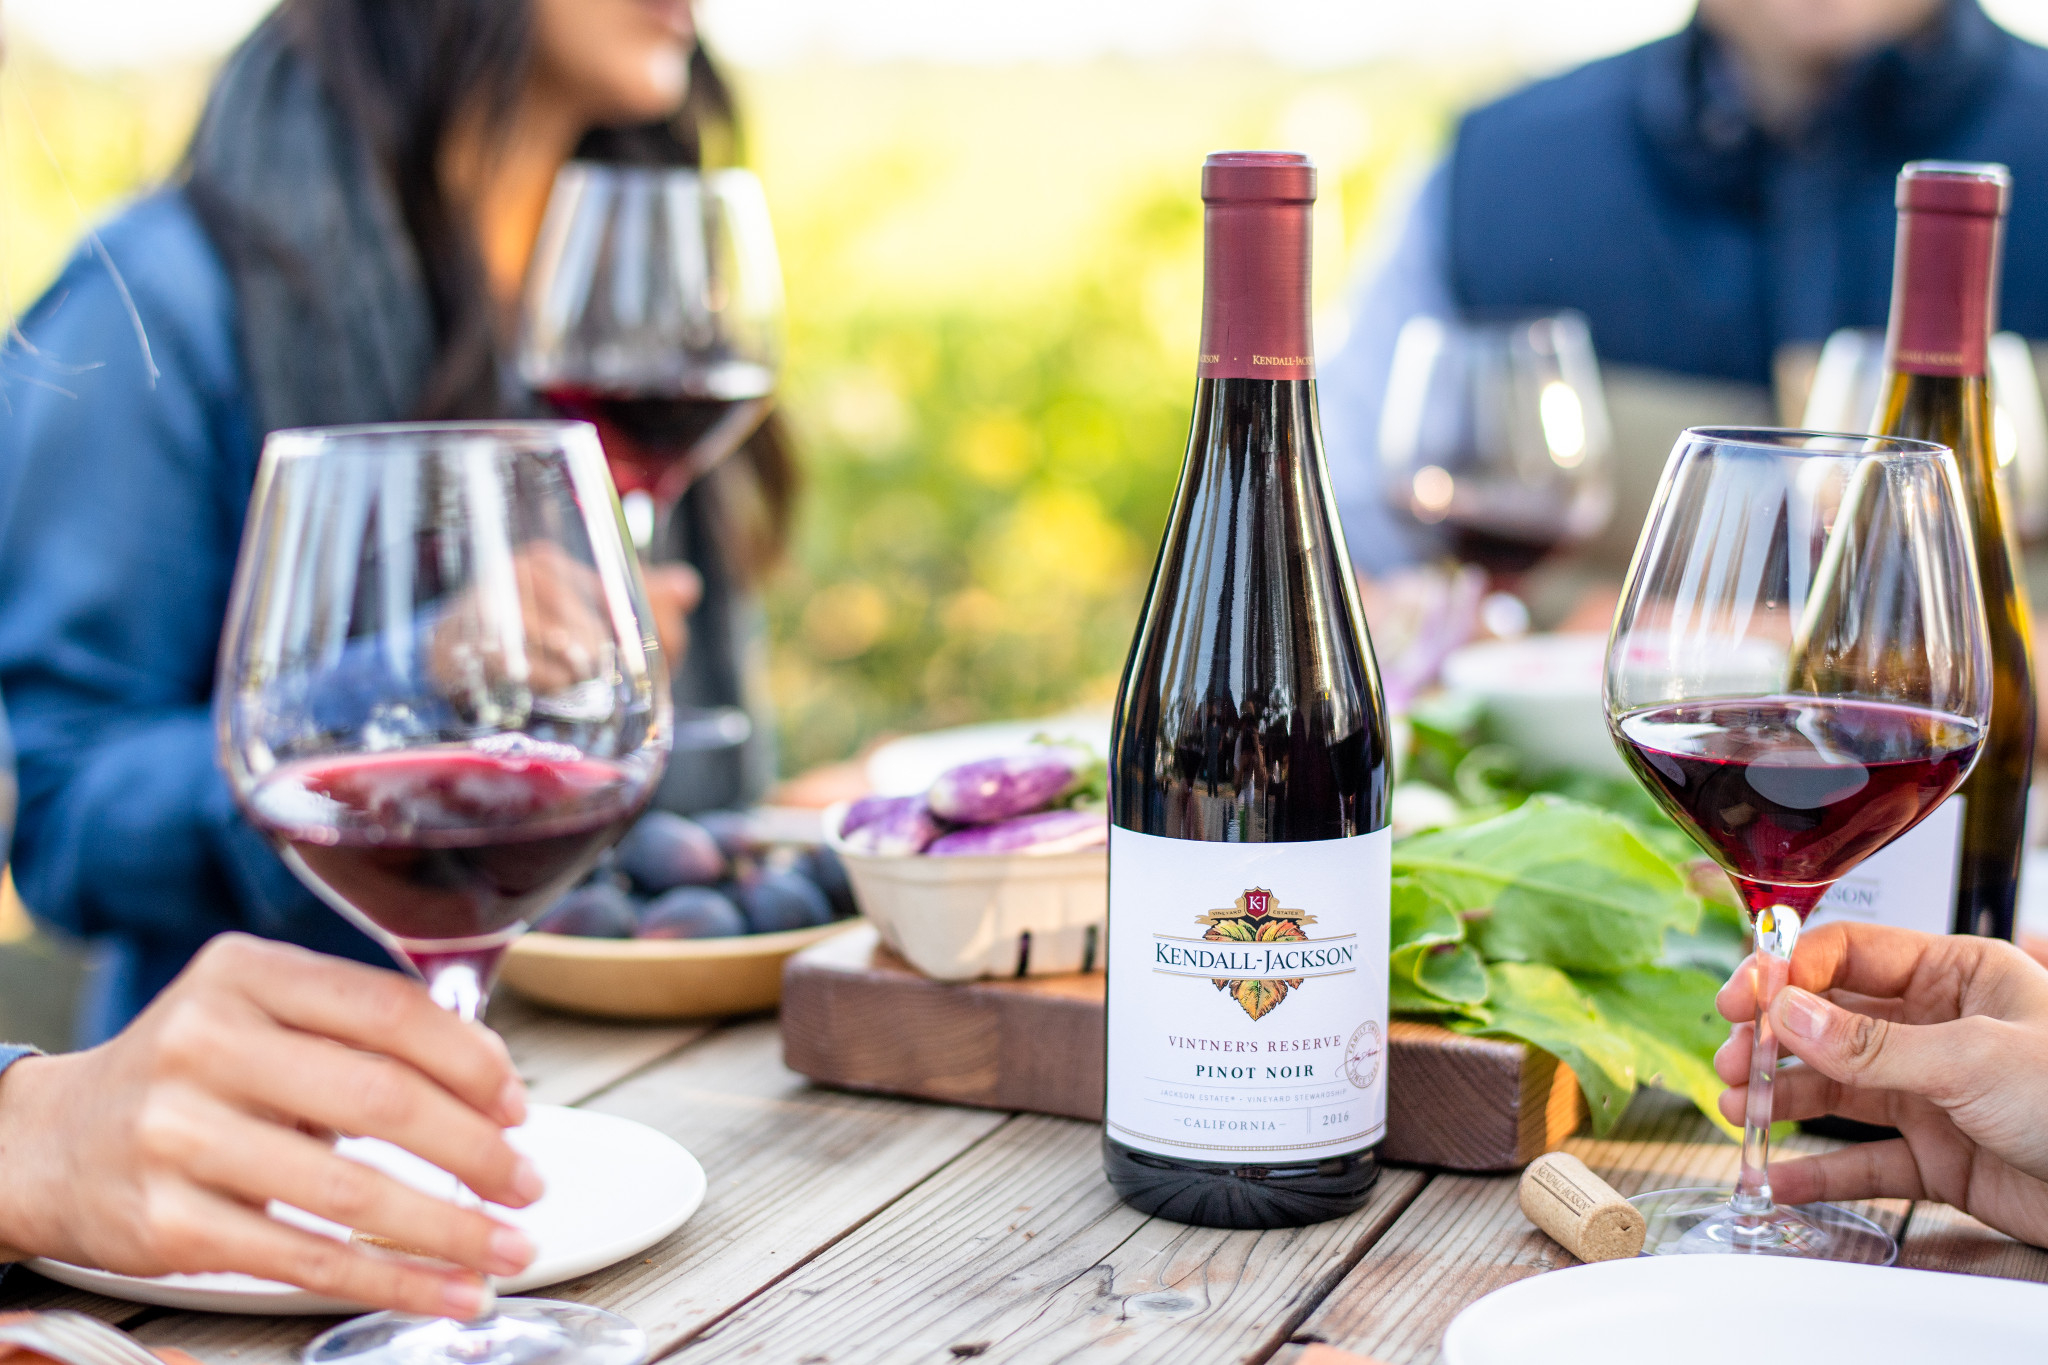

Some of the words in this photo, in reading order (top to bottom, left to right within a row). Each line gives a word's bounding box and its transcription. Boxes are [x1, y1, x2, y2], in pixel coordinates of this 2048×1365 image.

[1249, 895, 1267, 911] K-J
[1155, 942, 1354, 975] KENDALL-JACKSON
[1168, 1035, 1258, 1053] VINTNER'S
[1267, 1034, 1341, 1053] RESERVE
[1195, 1064, 1256, 1079] PINOT
[1266, 1064, 1314, 1079] NOIR
[1160, 1089, 1195, 1100] JACKSON
[1247, 1094, 1291, 1103] VINEYARD
[1294, 1087, 1347, 1101] STEWARDSHIP
[1183, 1116, 1276, 1131] CALIFORNIA
[1322, 1110, 1349, 1126] 2016
